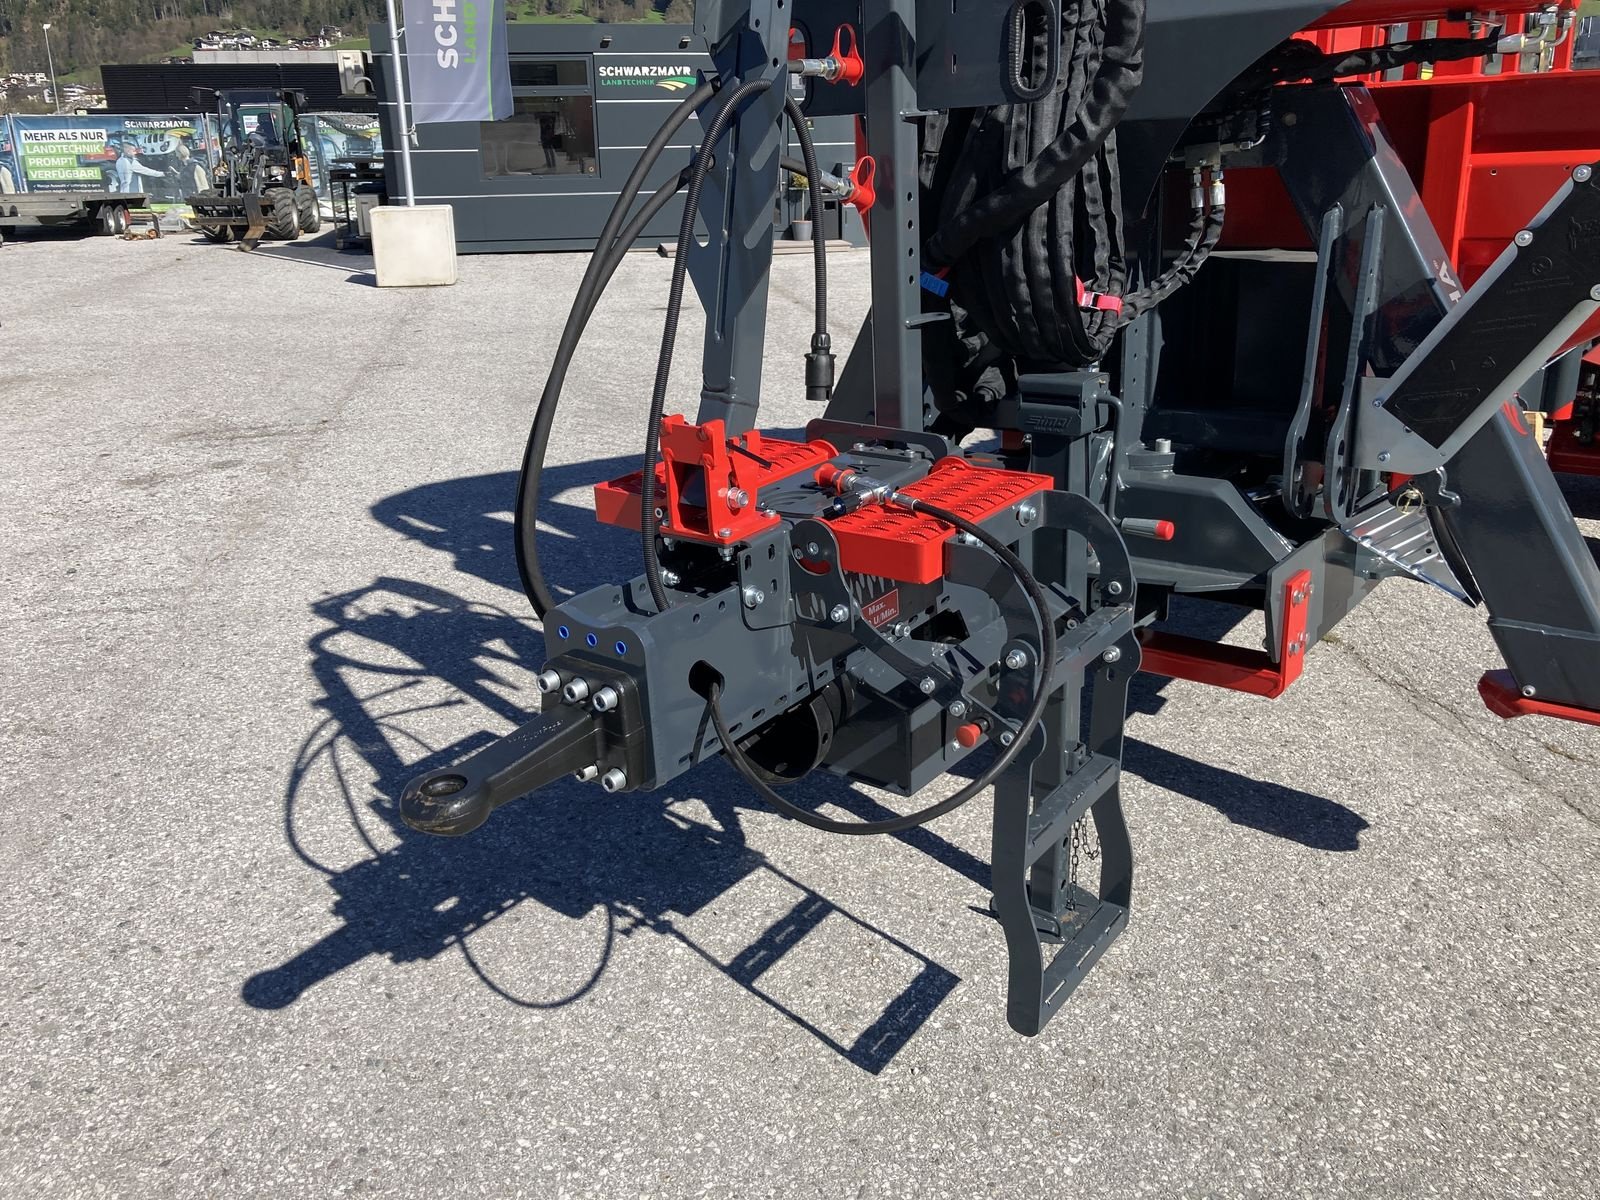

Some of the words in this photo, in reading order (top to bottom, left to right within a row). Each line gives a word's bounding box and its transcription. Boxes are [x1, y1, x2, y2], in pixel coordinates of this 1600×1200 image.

[432, 0, 459, 69] SCH
[599, 66, 691, 76] SCHWARZMAYR
[124, 120, 190, 129] SCHWARZMAYR
[24, 132, 56, 141] MEHR
[58, 131, 78, 140] ALS
[80, 131, 104, 140] NUR
[25, 144, 101, 154] LANDTECHNIK
[28, 157, 73, 166] PROMPT
[29, 168, 98, 179] VERFÜGBAR!
[868, 601, 886, 616] Max.
